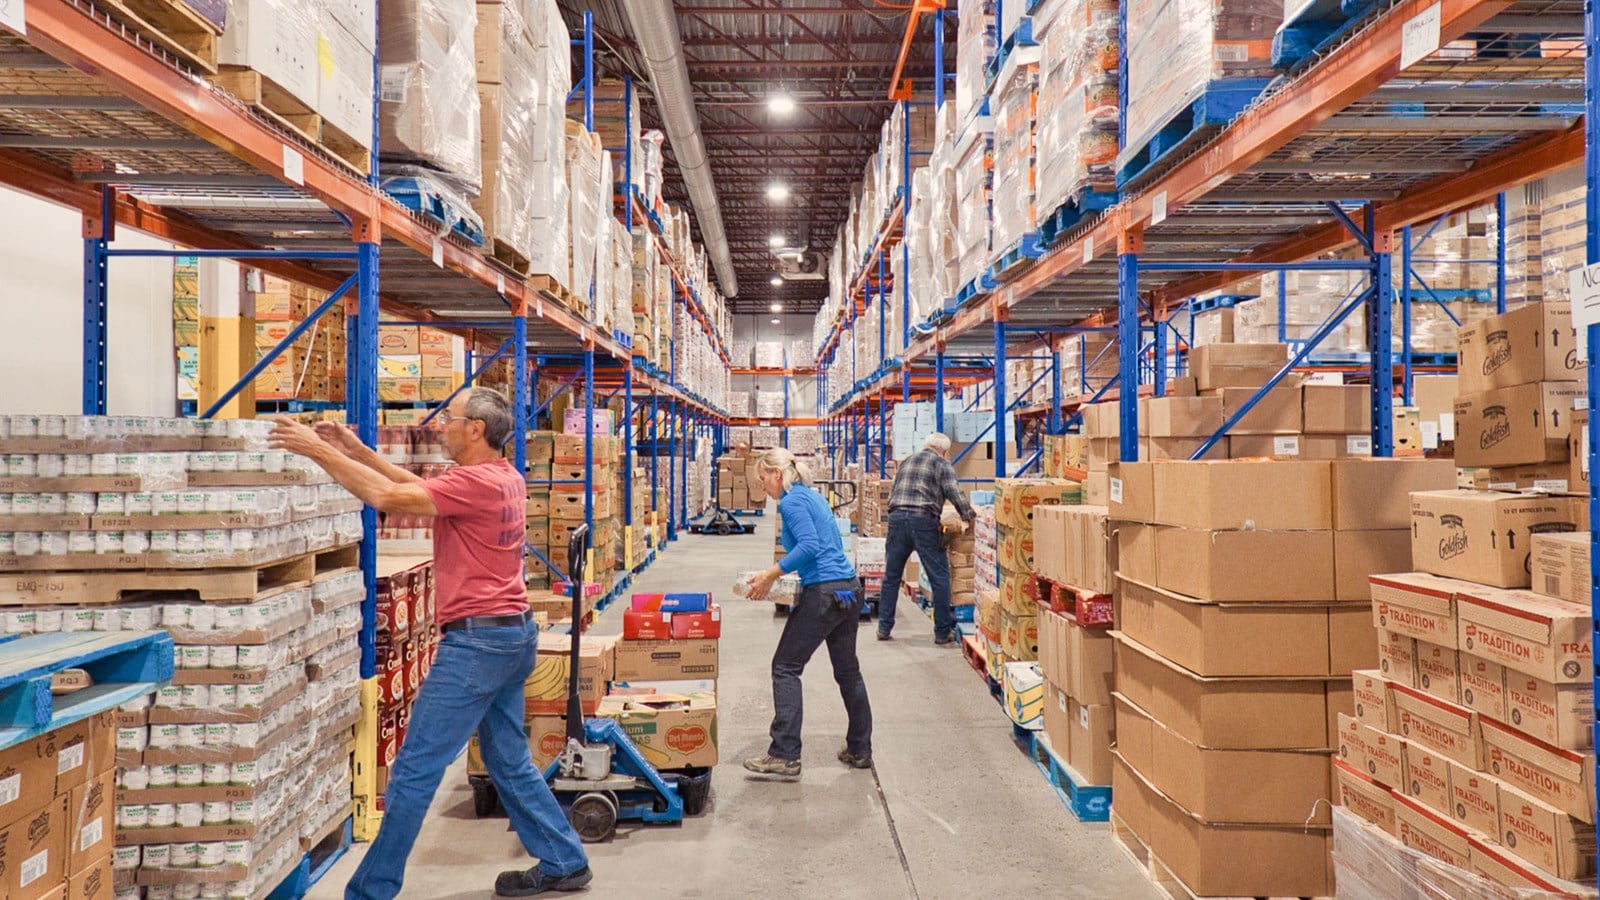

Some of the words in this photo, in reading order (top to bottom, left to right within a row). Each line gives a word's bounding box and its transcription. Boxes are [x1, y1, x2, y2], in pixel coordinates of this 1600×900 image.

[1482, 342, 1512, 376] Goldfish
[1480, 417, 1510, 450] Goldfish
[1439, 530, 1468, 560] Goldfish
[1389, 609, 1435, 630] TRADITION
[1380, 644, 1410, 660] TRADITION
[1478, 631, 1530, 659] TRADITION
[1561, 643, 1591, 654] TRA
[1420, 659, 1454, 678] TRADITION
[1463, 672, 1501, 694] TRADITION
[1356, 689, 1384, 706] TRADITION
[1510, 690, 1555, 717] TRADITION
[1410, 718, 1455, 746] TRADITION
[1367, 745, 1399, 765] TRADITION
[1410, 764, 1446, 790] TRADITION
[1504, 757, 1561, 794] TRADITION
[1350, 792, 1385, 820] TRADITION
[1454, 785, 1496, 814] TRADITION
[1504, 813, 1552, 845] TRADITION
[1410, 829, 1454, 865] TRADITION
